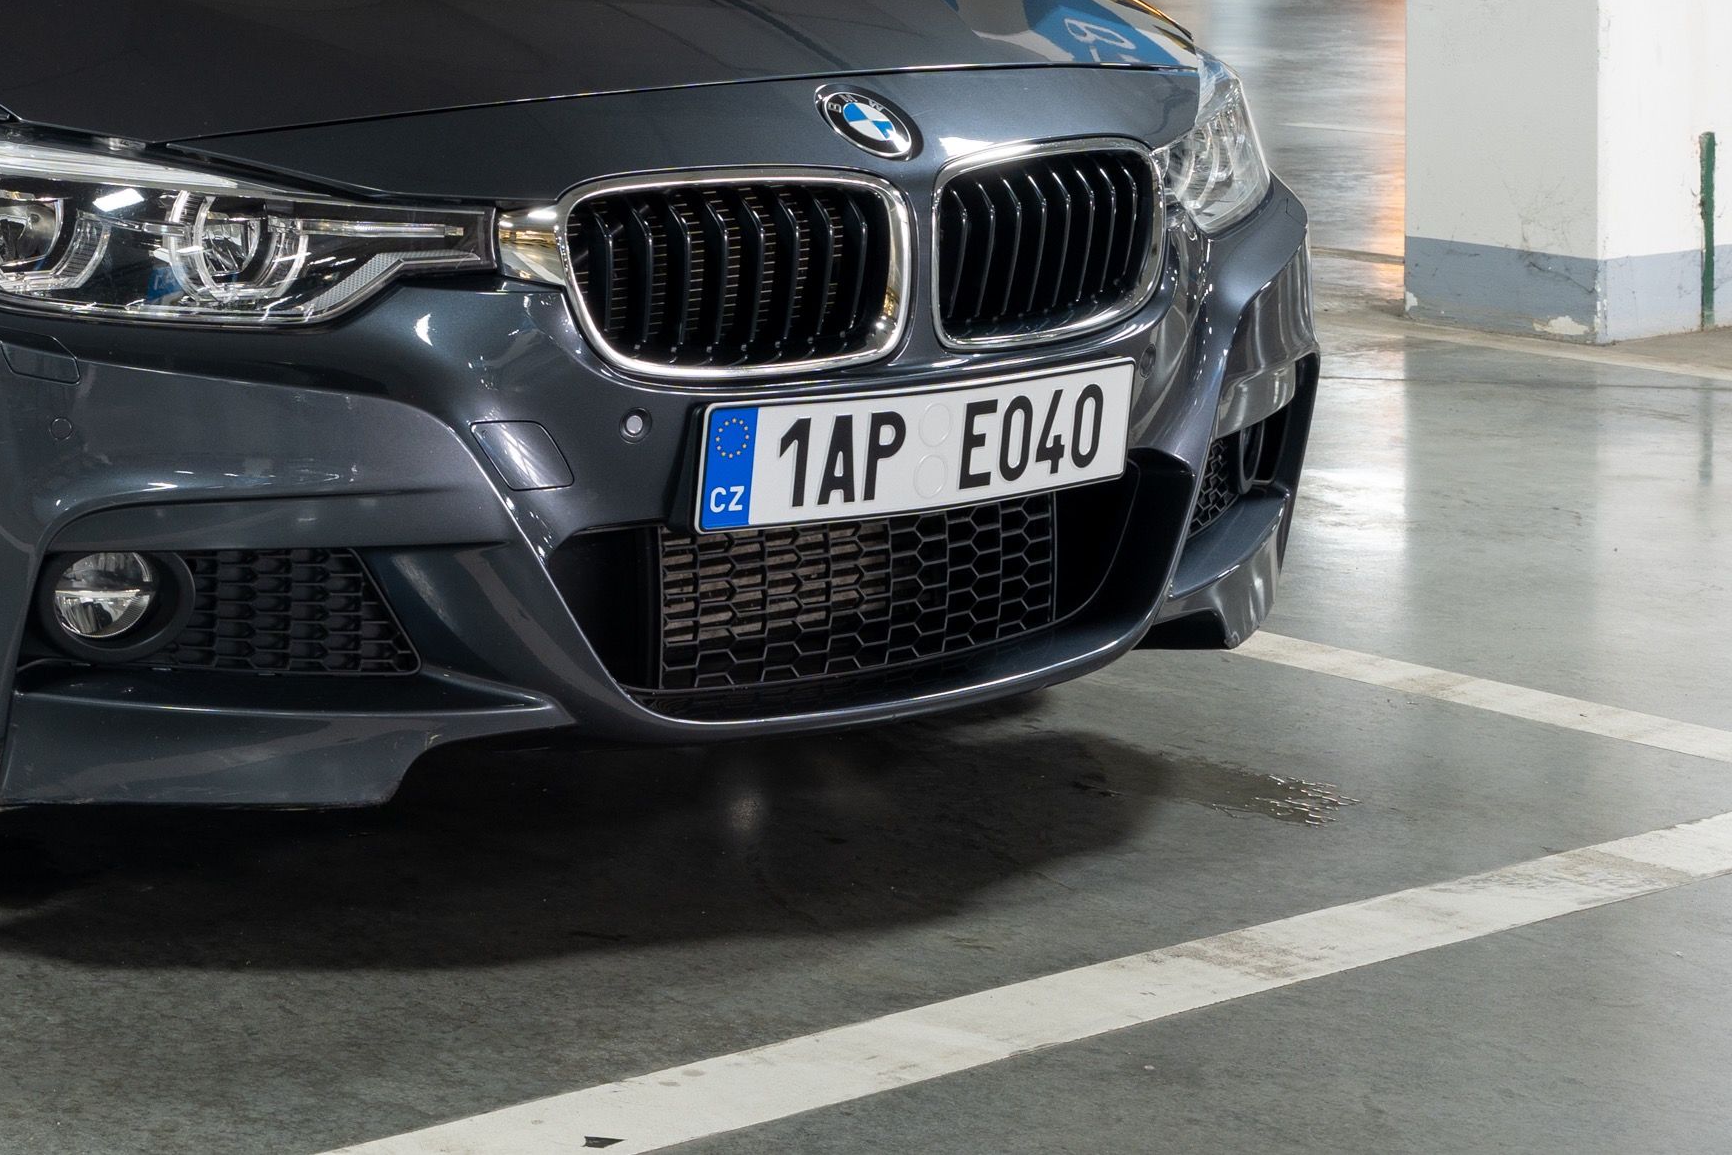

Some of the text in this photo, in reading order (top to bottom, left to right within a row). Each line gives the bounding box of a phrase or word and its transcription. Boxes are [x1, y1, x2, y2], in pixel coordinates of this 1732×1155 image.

[778, 383, 1105, 509] 1AP E040
[709, 485, 745, 514] CZ
